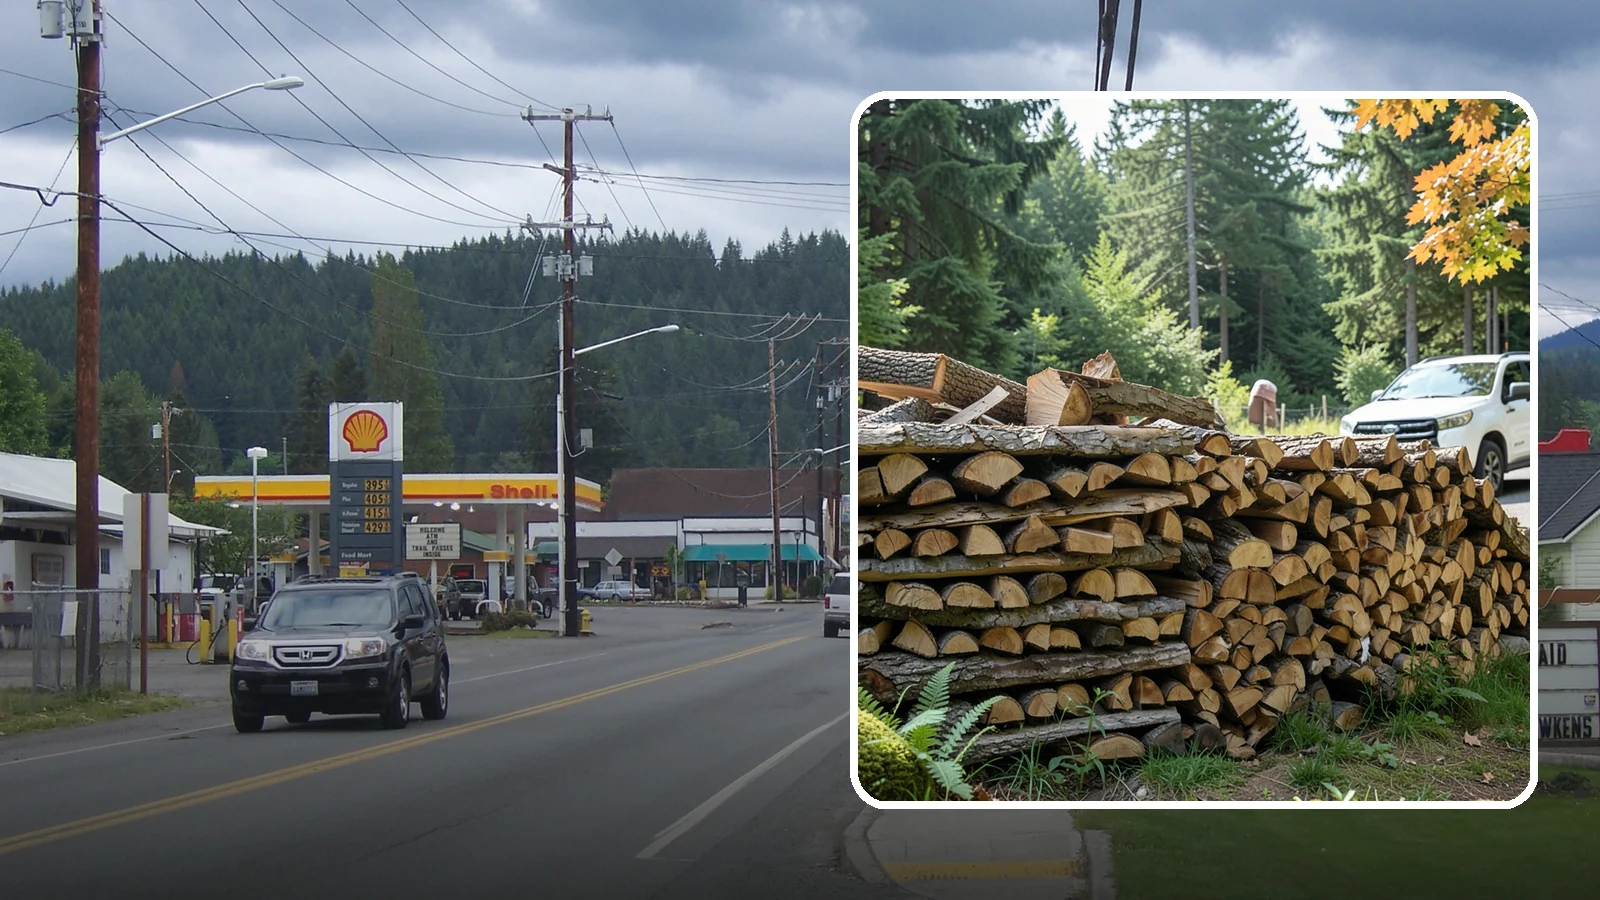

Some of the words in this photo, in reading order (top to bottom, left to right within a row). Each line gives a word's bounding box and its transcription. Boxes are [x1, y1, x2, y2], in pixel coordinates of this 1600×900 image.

[366, 480, 384, 490] 395
[490, 484, 548, 499] Shell
[366, 494, 384, 504] 405
[366, 508, 383, 518] 415
[366, 522, 384, 533] 429
